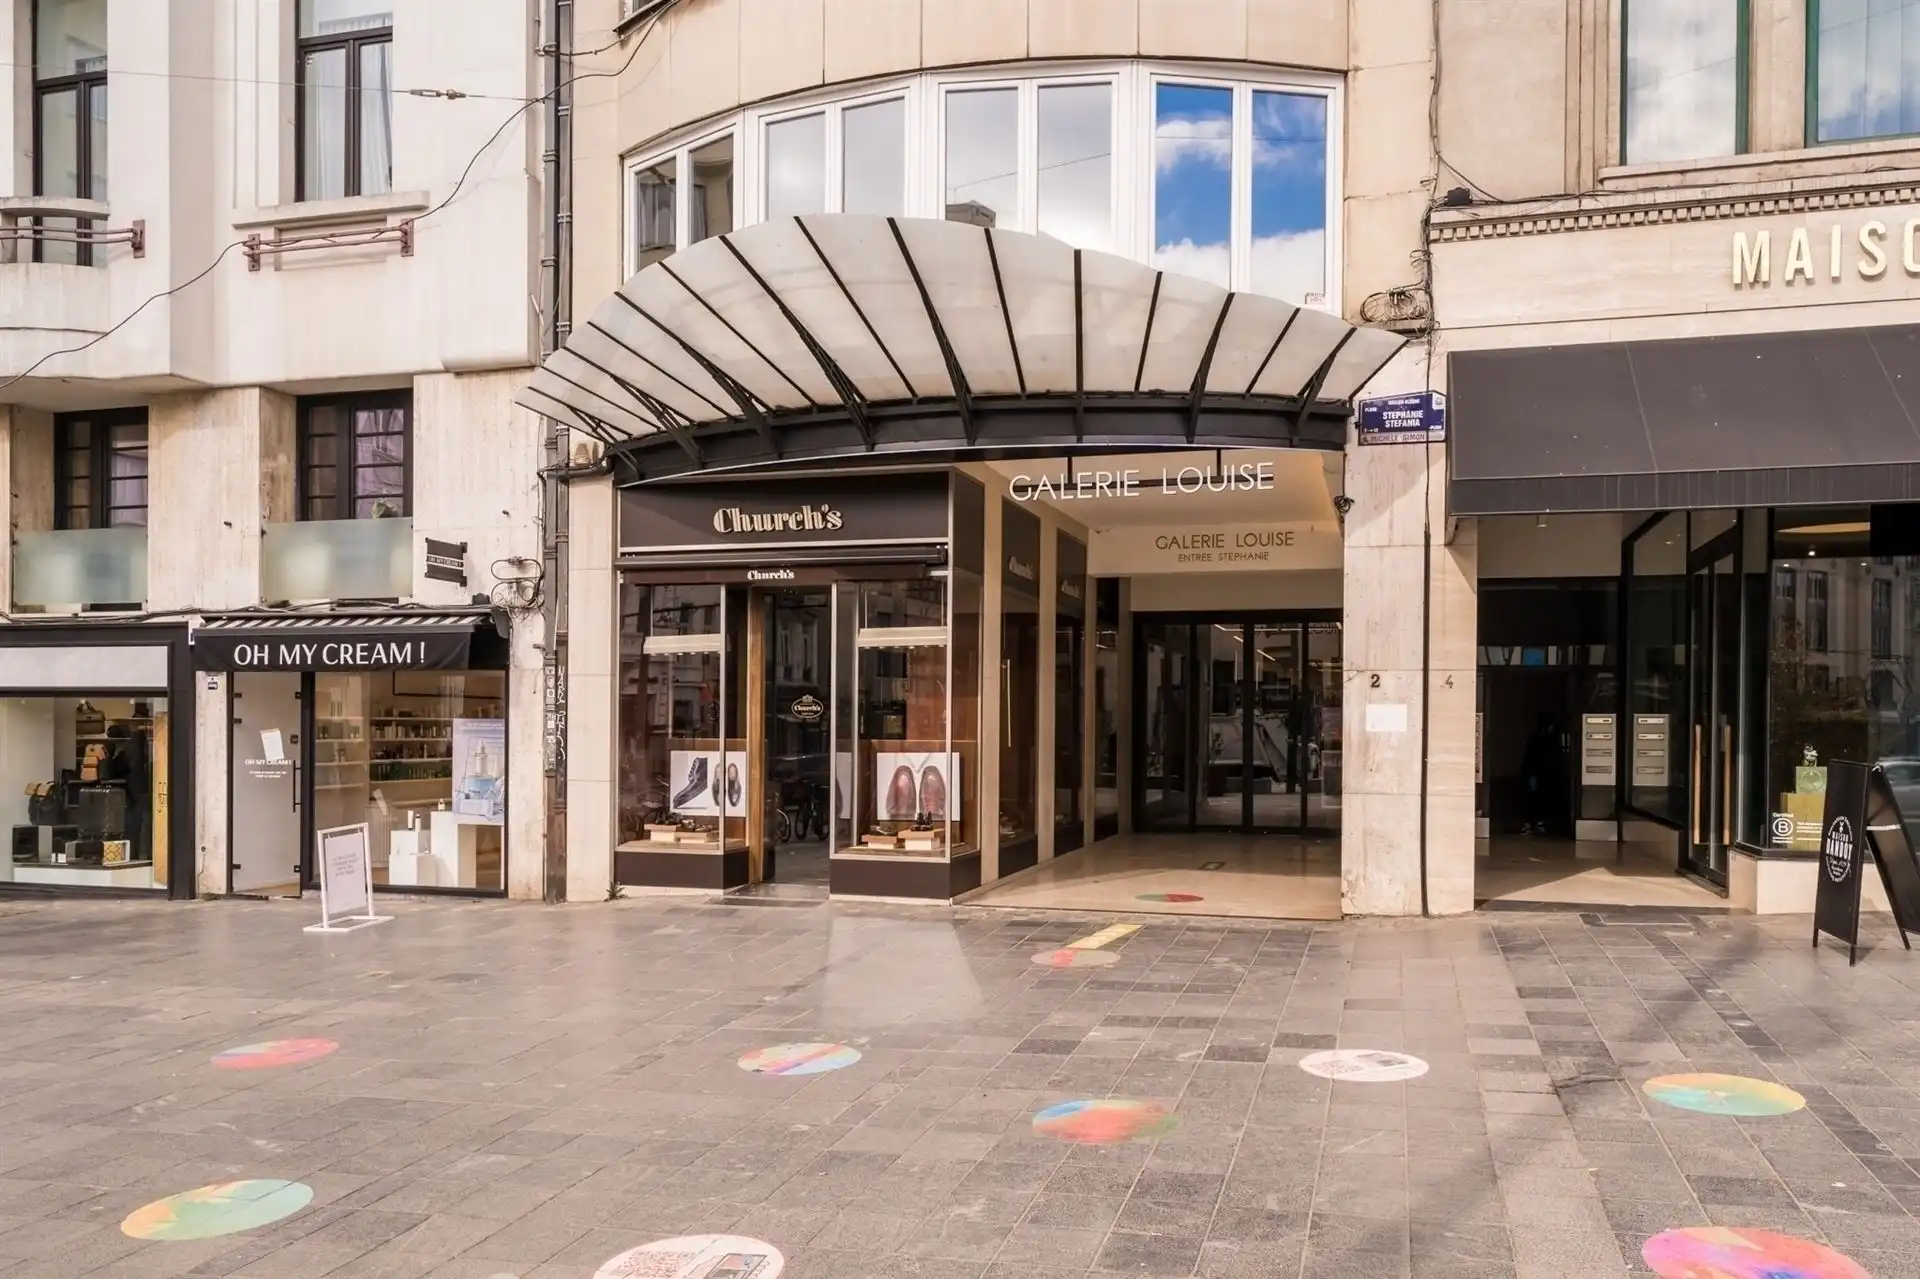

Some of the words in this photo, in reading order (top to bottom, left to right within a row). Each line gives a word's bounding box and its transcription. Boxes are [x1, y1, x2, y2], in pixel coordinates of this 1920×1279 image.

[1382, 410, 1424, 420] STEPHANIE
[1385, 419, 1420, 428] STEFANIA
[1009, 469, 1140, 501] GALERIE
[1162, 462, 1275, 495] LOUISE
[713, 504, 843, 533] Church's
[1155, 533, 1225, 550] GALERIE
[1236, 531, 1295, 548] LOUISE
[1218, 551, 1270, 562] STEPHANIE
[747, 569, 795, 580] Church's
[233, 643, 269, 665] OH
[279, 643, 318, 665] MY
[321, 642, 412, 665] CREAM
[419, 641, 426, 663] !
[1370, 673, 1381, 688] 2
[1444, 674, 1454, 689] 4
